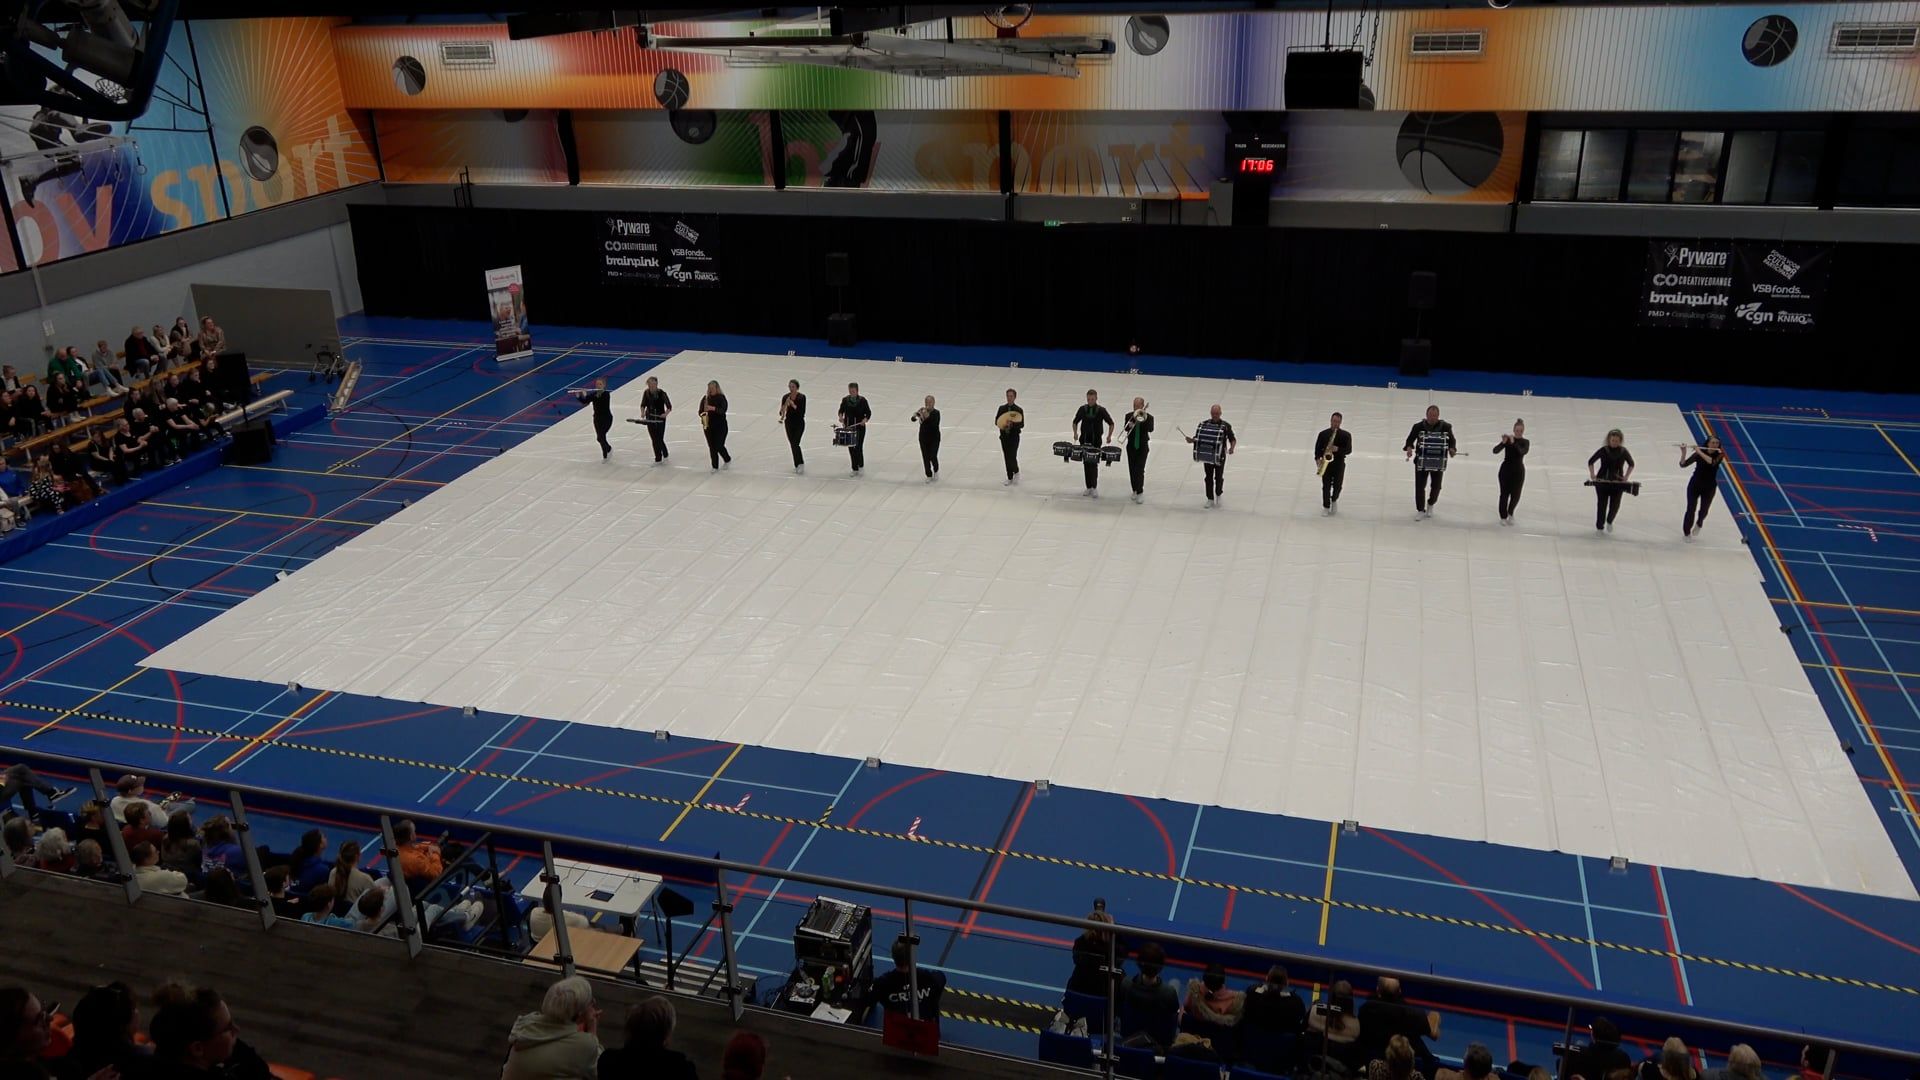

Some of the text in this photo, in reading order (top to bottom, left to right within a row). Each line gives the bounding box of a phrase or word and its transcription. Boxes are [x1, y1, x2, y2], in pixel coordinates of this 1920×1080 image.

[1241, 159, 1275, 172] 17:06
[617, 219, 650, 236] Pyware
[606, 254, 660, 268] brainpink
[1679, 247, 1728, 267] Pyware
[673, 270, 693, 282] cgn
[1678, 275, 1732, 288] CREATIVEORANGE
[1649, 290, 1729, 307] brainpink
[1746, 310, 1774, 325] cgn
[888, 987, 931, 1003] CRW
